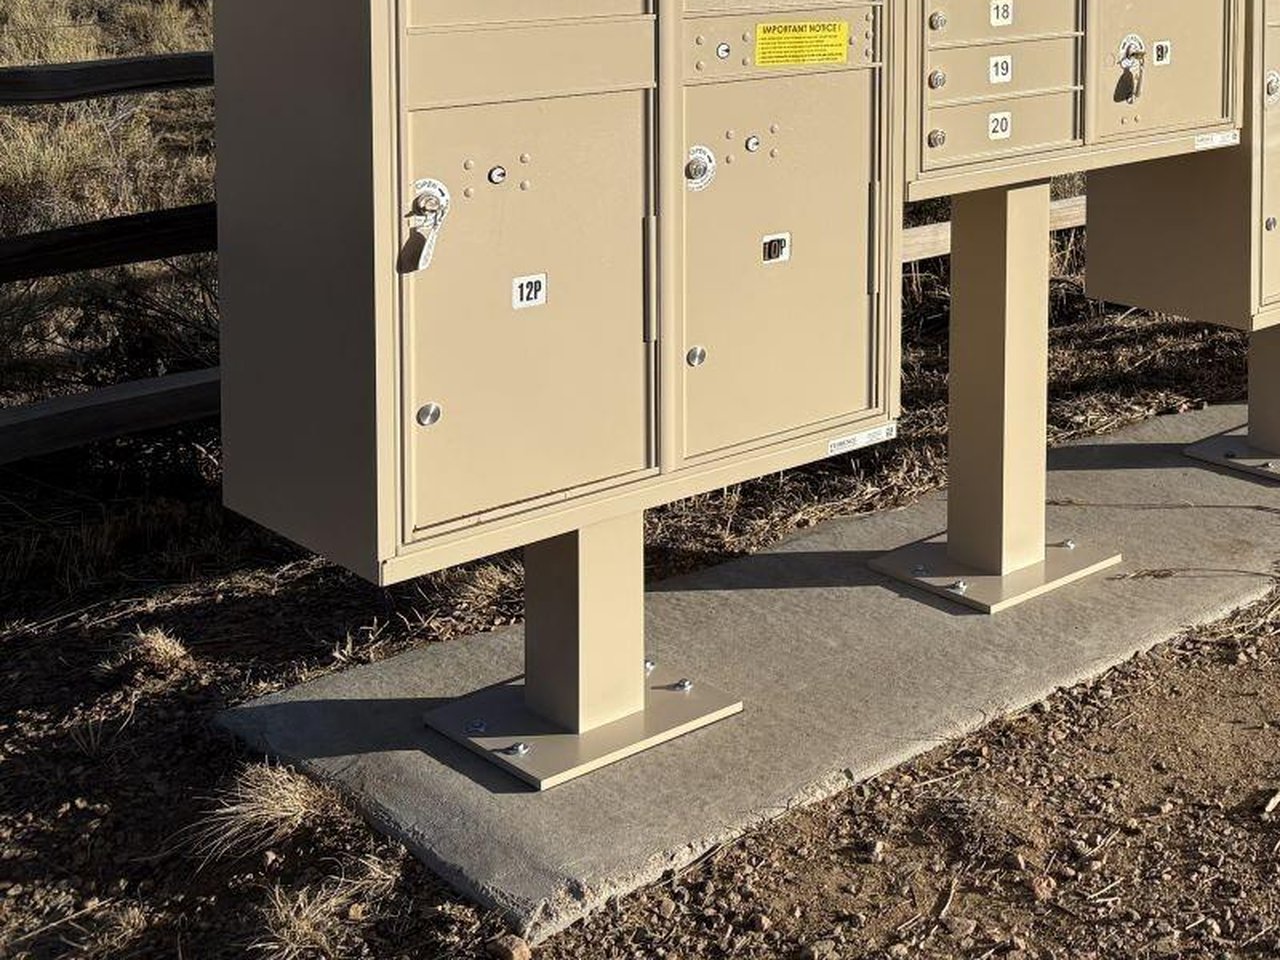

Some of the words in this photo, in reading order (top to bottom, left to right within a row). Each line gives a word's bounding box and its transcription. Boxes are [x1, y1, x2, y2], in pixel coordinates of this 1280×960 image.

[993, 4, 1010, 20] 18
[762, 24, 807, 34] IMPORTANT
[992, 60, 1009, 76] 19
[991, 117, 1008, 134] 20
[415, 179, 438, 190] OPEN
[763, 238, 787, 261] 10P
[518, 280, 543, 302] 12P
